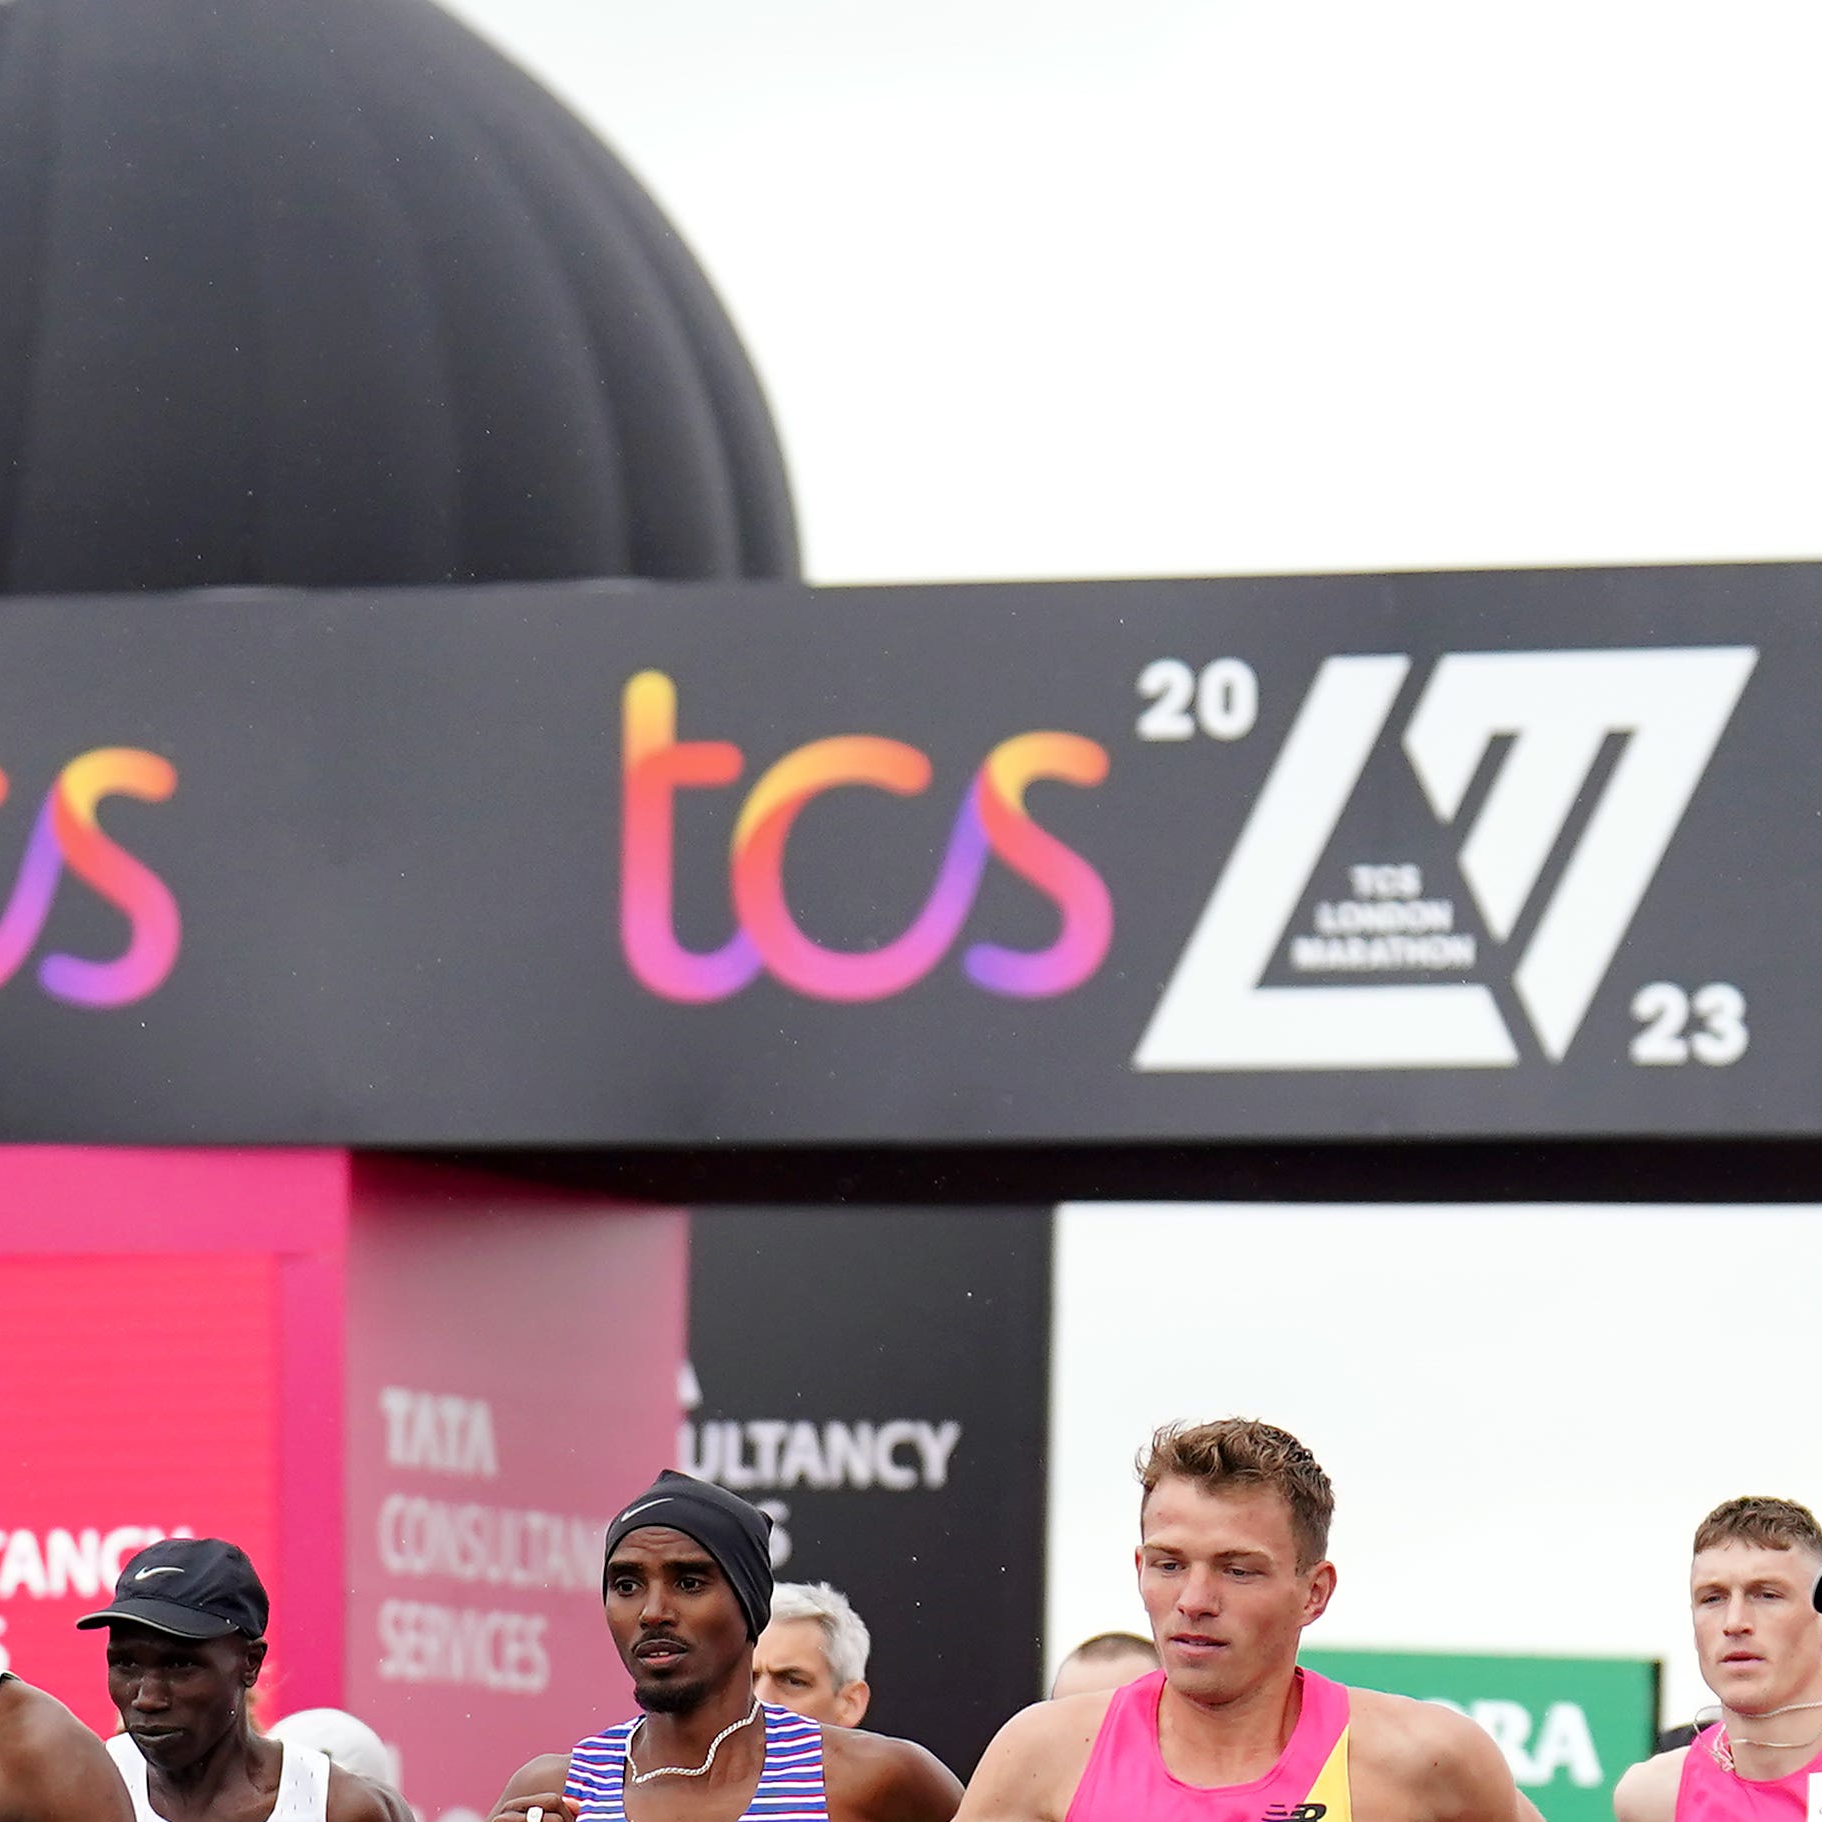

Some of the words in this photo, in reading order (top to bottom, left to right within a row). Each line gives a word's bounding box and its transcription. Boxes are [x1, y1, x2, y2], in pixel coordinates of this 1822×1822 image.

[1135, 657, 1260, 741] 20
[620, 669, 1114, 1003] tcs
[1290, 934, 1476, 972] MARATHON
[1313, 900, 1455, 936] LONDON
[1630, 983, 1749, 1067] 23
[380, 1385, 500, 1477] TATA
[380, 1597, 555, 1696] SERVICES
